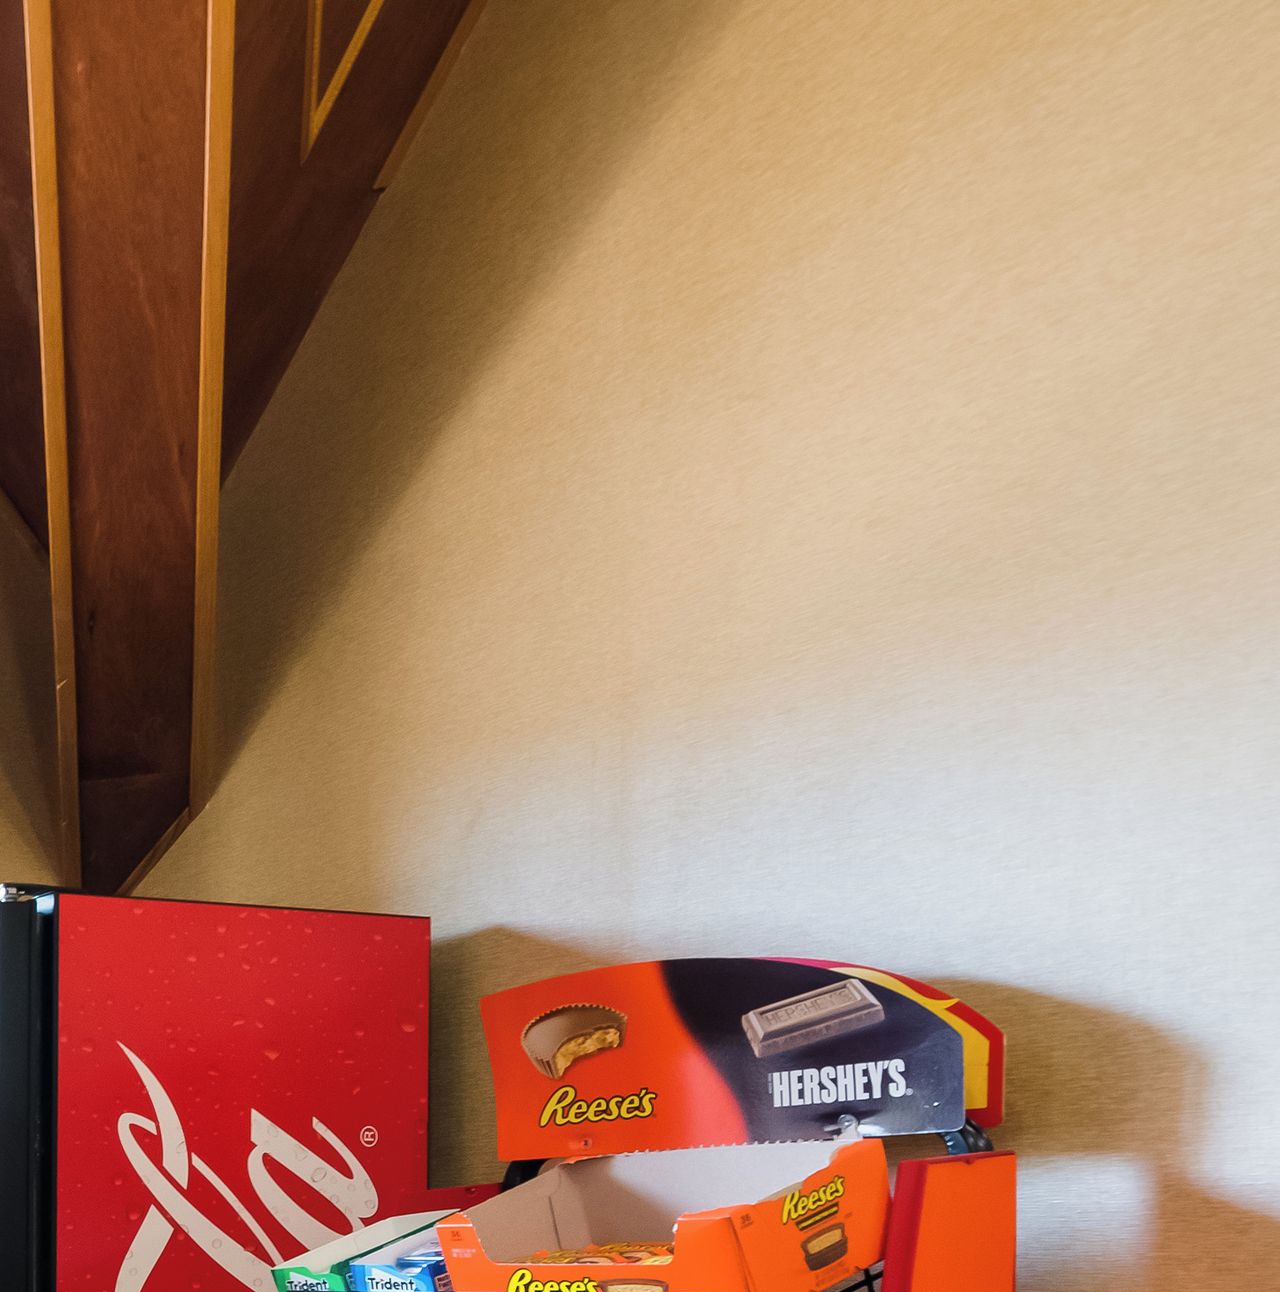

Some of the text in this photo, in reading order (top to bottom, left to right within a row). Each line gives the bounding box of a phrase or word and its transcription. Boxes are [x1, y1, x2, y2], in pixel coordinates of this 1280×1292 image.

[773, 1059, 907, 1108] HERSHEY'S
[540, 1085, 657, 1128] Reese's
[782, 1175, 845, 1225] Reese's
[287, 1278, 328, 1292] Trident
[368, 1278, 415, 1291] Trident
